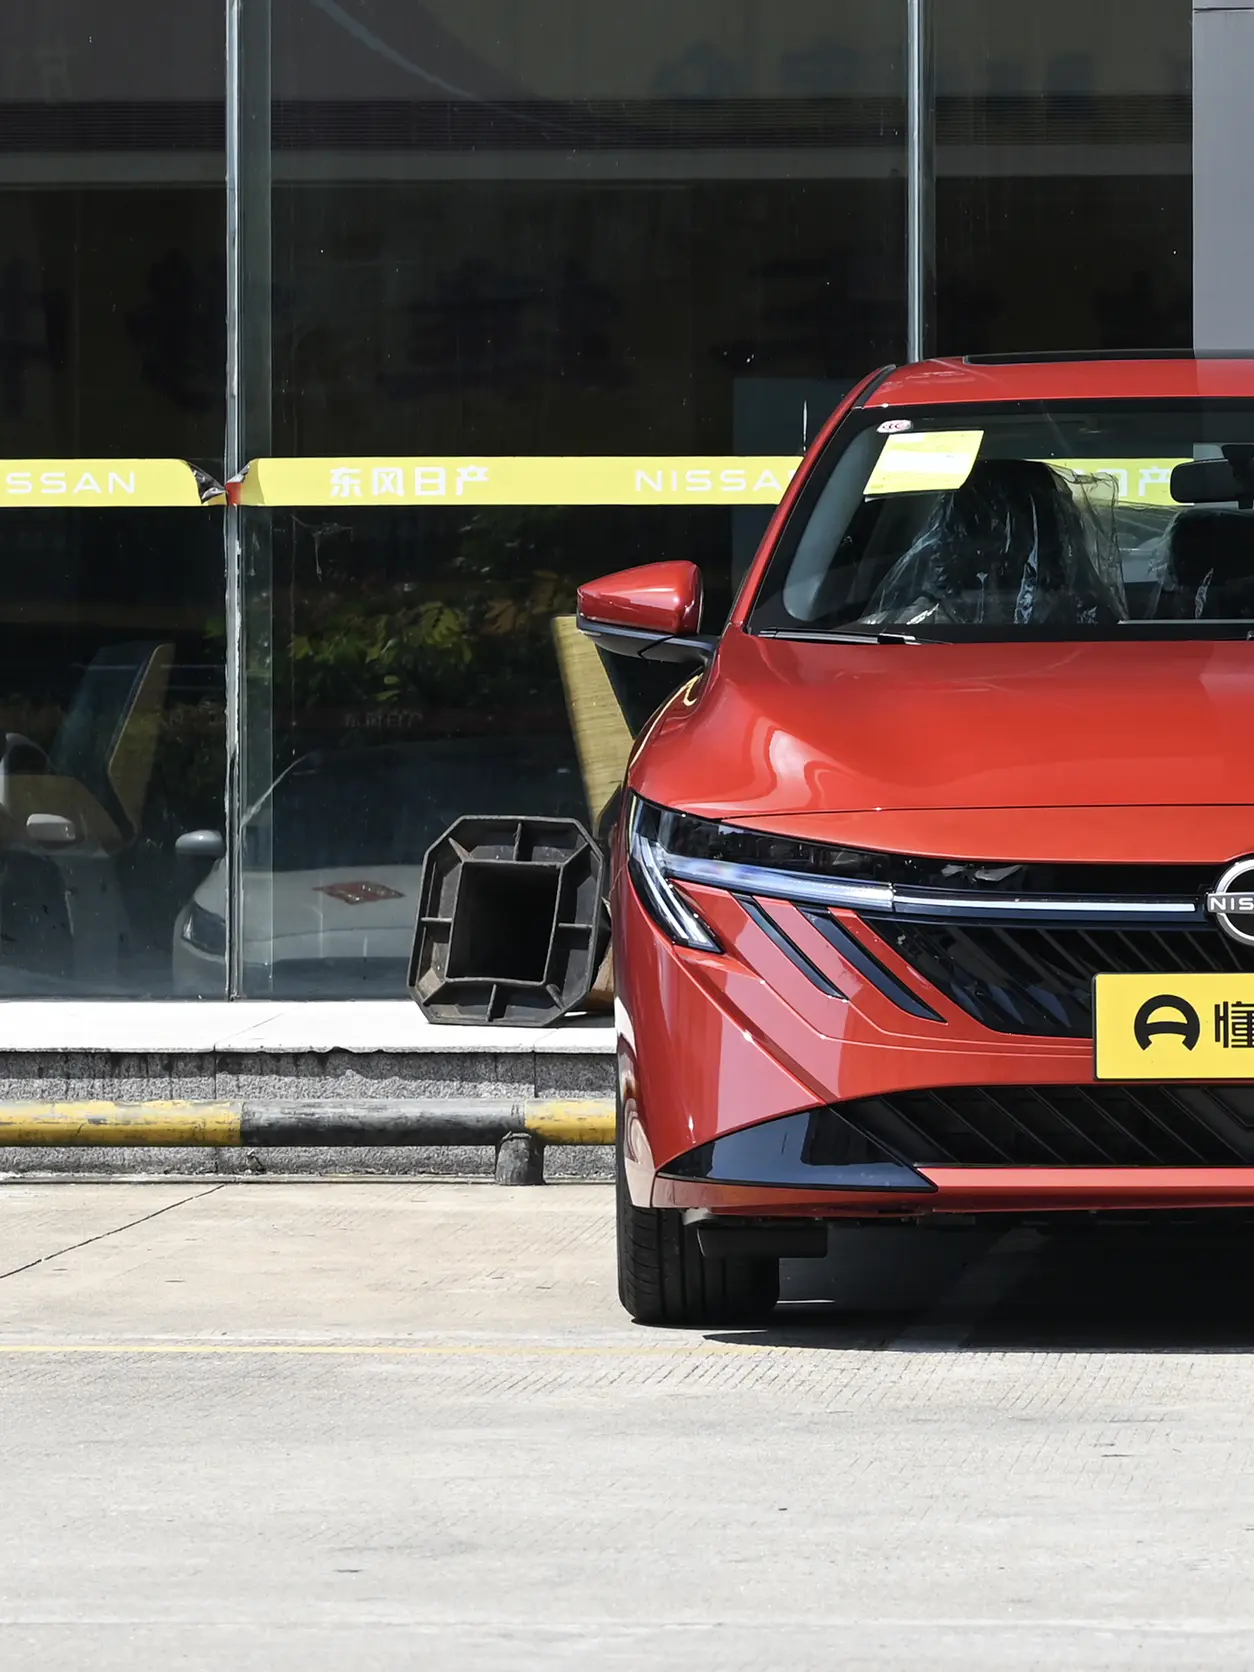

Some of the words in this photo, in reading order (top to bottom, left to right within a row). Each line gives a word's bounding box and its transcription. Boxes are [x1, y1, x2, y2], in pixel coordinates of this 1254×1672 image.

[5, 471, 136, 494] SSAN
[329, 465, 489, 497] 东风日产
[634, 469, 797, 492] NISSA
